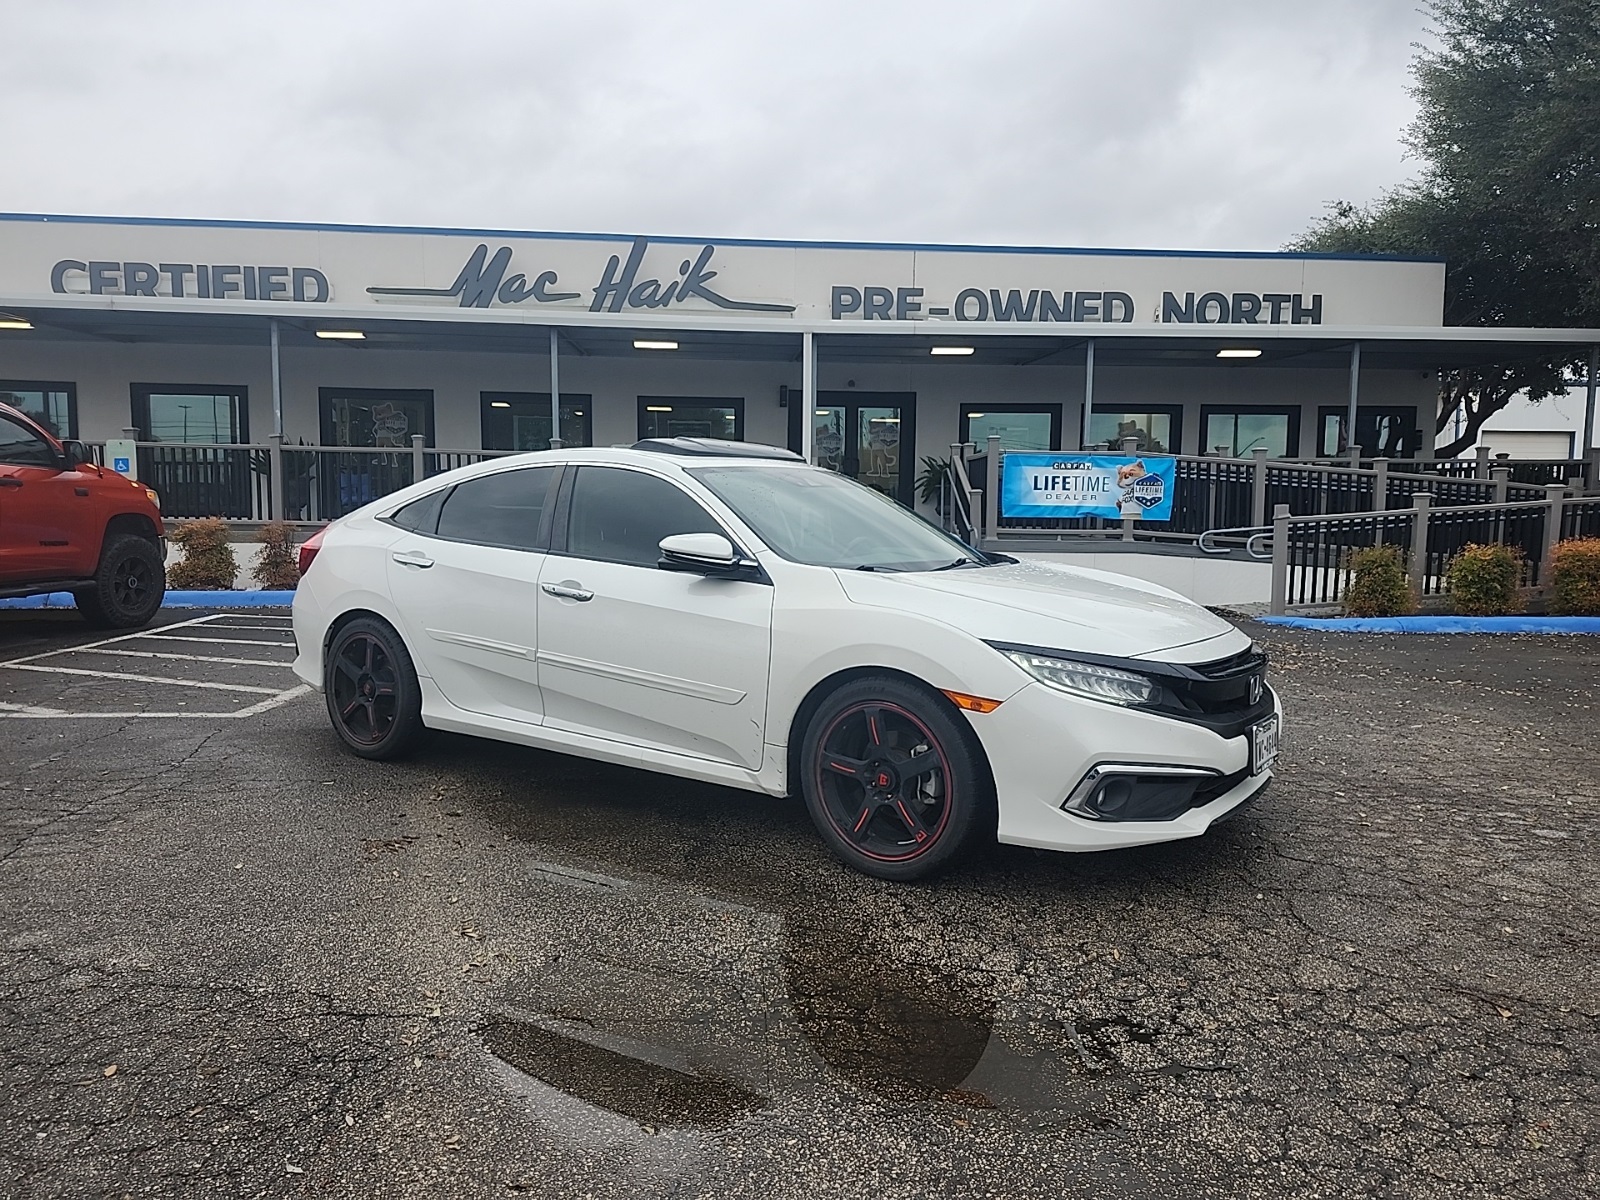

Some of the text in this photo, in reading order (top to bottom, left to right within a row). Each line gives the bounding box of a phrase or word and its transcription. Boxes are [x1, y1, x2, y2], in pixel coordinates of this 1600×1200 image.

[50, 236, 1323, 325] CERTIFIED Mac Haik PRE-OWNED NORTH
[1053, 462, 1093, 470] CARFAX
[1033, 475, 1111, 492] LIFETIME
[1045, 493, 1097, 501] DEALER
